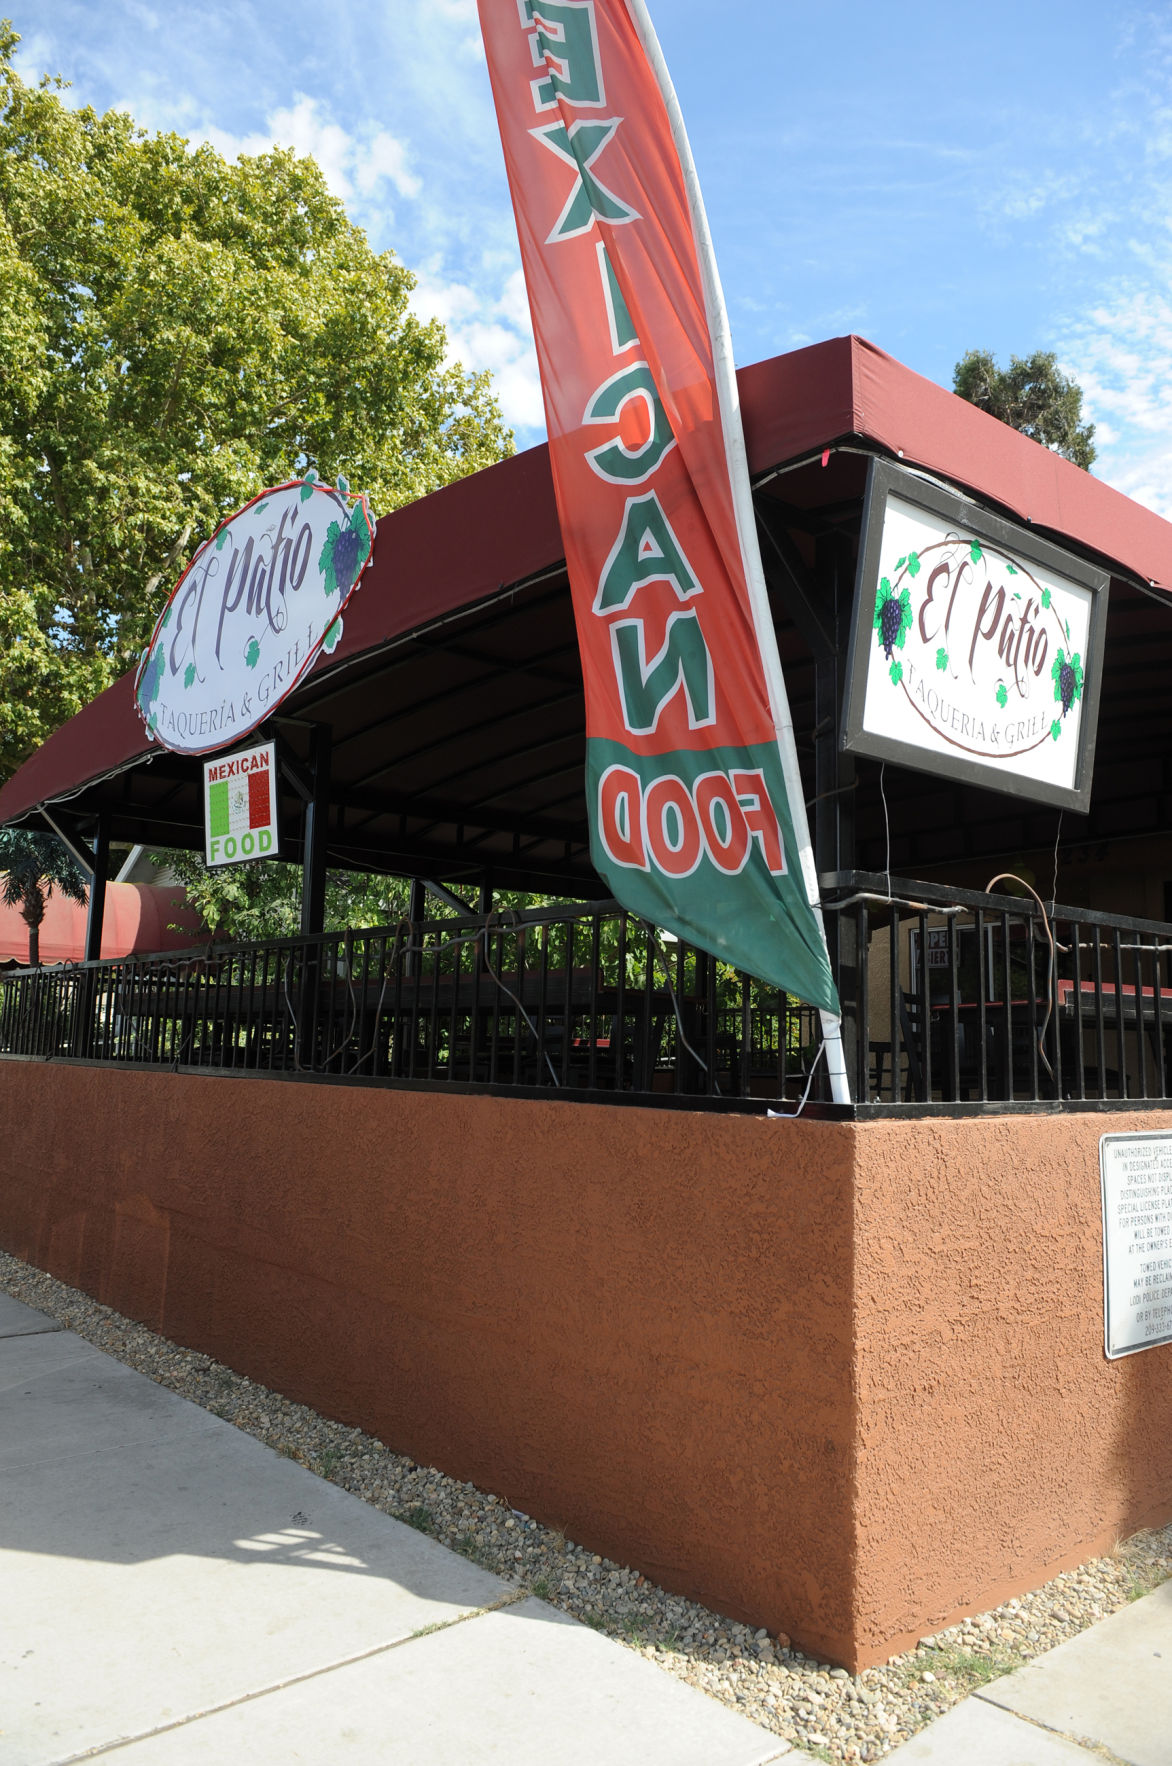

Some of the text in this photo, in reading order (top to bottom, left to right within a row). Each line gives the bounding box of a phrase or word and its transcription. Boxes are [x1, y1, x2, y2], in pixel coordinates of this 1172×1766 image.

[169, 503, 313, 684] El Patio
[919, 556, 1048, 698] El Patio
[241, 691, 252, 719] &
[258, 620, 318, 708] GRILL
[906, 658, 1048, 749] TAQUERIA & GRILL
[208, 751, 270, 783] MEXICAN
[210, 829, 272, 862] FOOD
[1113, 1147, 1151, 1159] UNAUTHORIZED
[1122, 1161, 1128, 1172] IN
[1129, 1159, 1160, 1171] DESIGNATED
[1127, 1174, 1147, 1186] SPACES
[1147, 1172, 1156, 1184] NOT
[1120, 1186, 1160, 1200] DISTINGUISHING
[1117, 1202, 1139, 1215] SPECIAL
[1139, 1199, 1160, 1211] LICENSE
[1119, 1216, 1129, 1228] FOR
[1130, 1213, 1153, 1226] PERSONS
[1155, 1211, 1166, 1222] WITH
[1134, 1225, 1169, 1240] WILL BE TOWED
[1128, 1243, 1135, 1255] AT
[1135, 1242, 1145, 1253] THE
[1146, 1239, 1168, 1252] OWNER'S
[1140, 1261, 1156, 1273] TOWED
[1133, 1277, 1143, 1288] MAY
[1145, 1275, 1152, 1286] BE
[1129, 1294, 1141, 1306] LODI
[1142, 1290, 1160, 1303] POLICE
[1136, 1311, 1144, 1323] OR
[1144, 1309, 1152, 1321] BY
